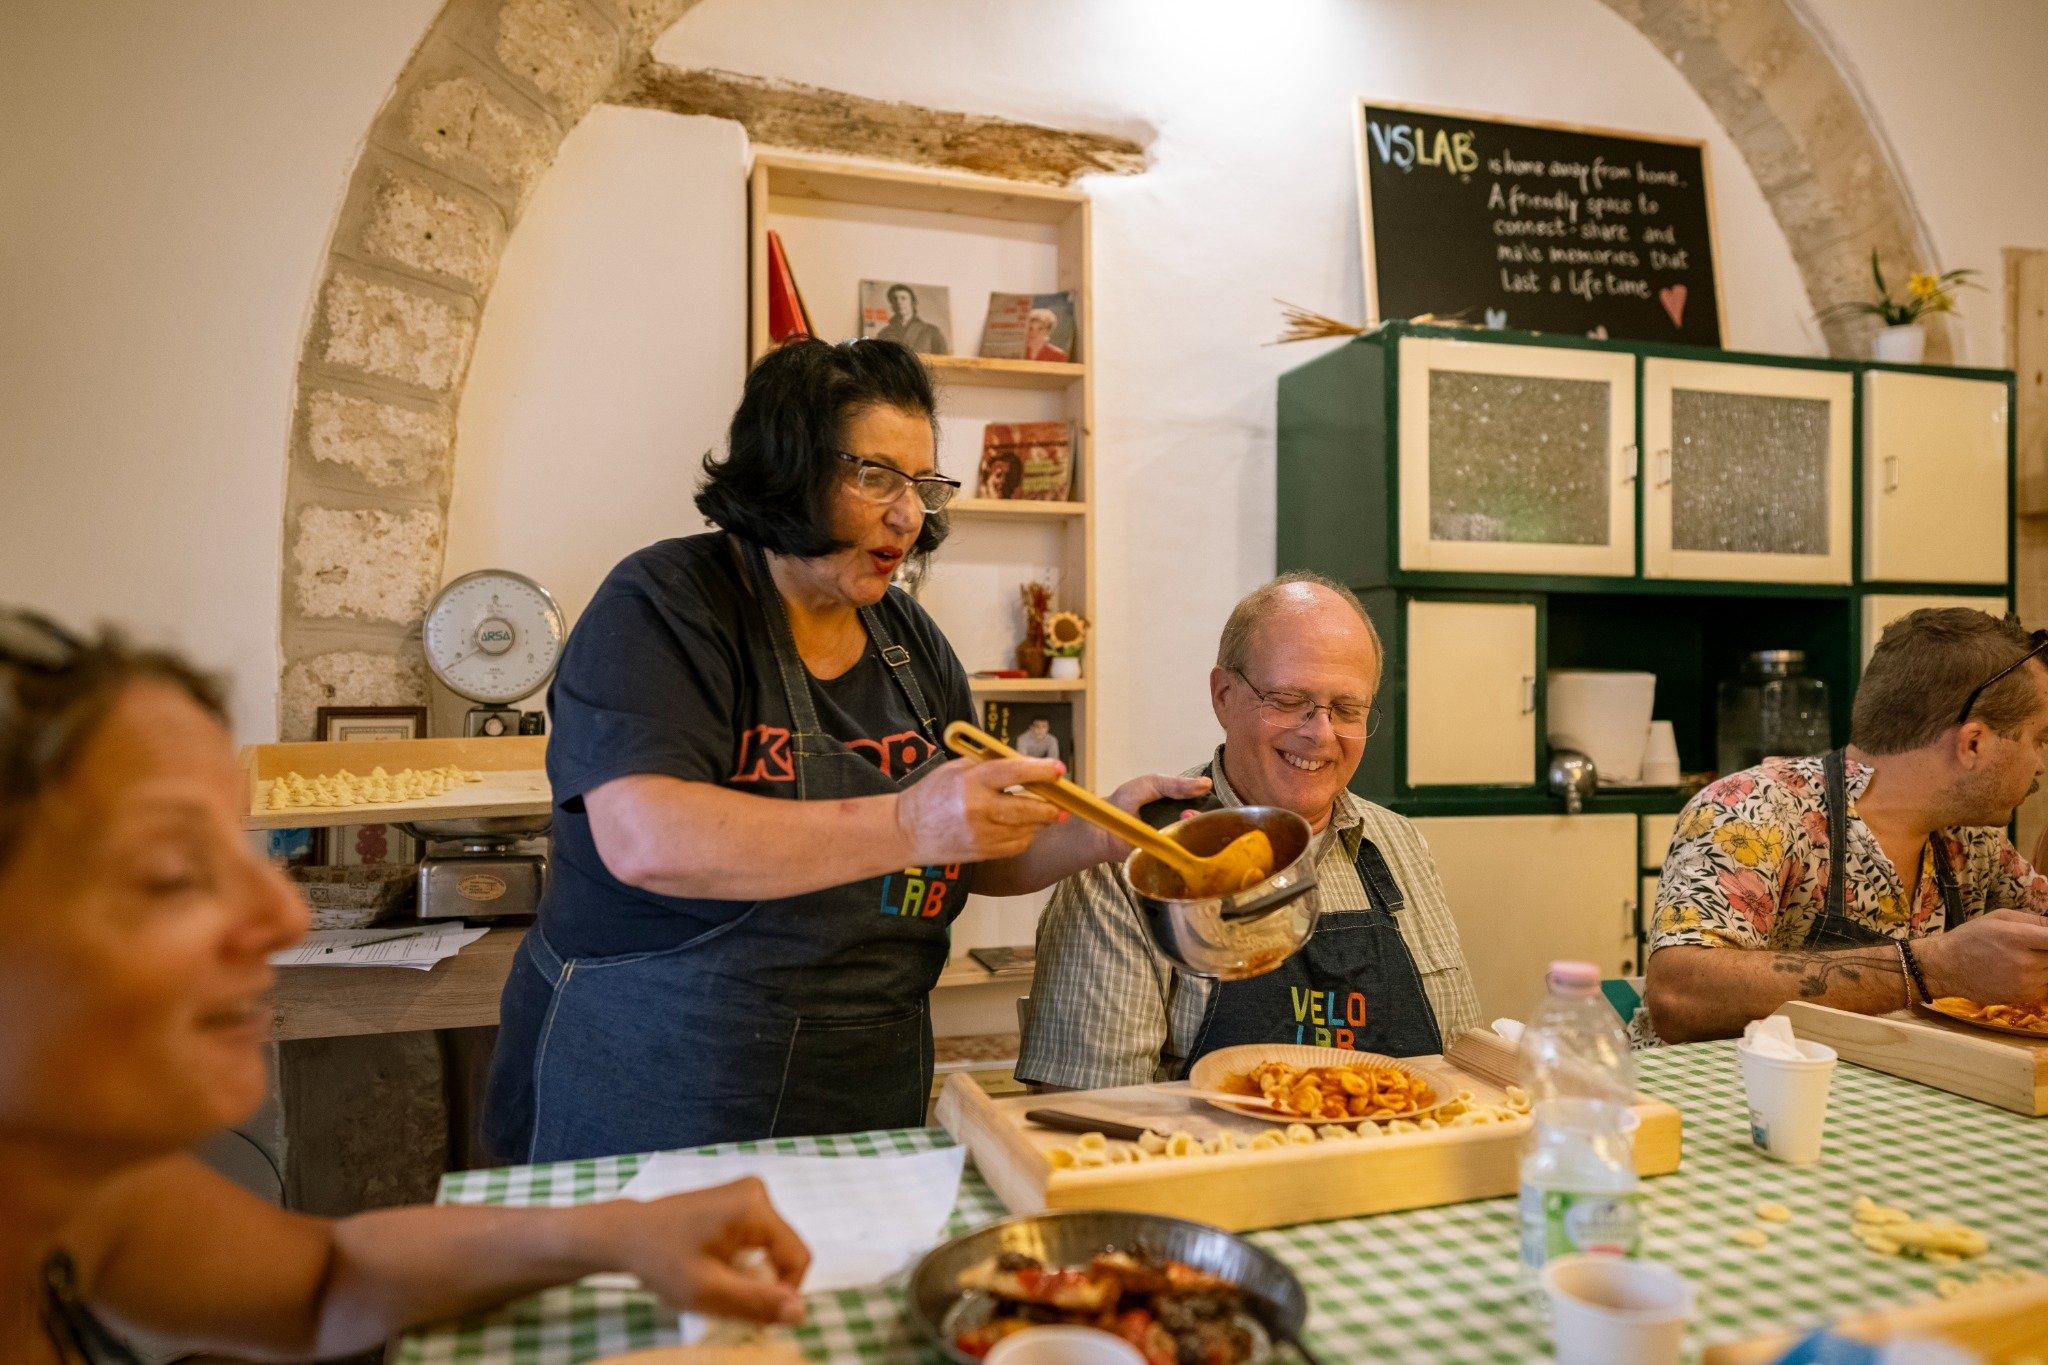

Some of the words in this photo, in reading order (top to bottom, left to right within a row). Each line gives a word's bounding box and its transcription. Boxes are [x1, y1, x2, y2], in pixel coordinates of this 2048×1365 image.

[1503, 148, 1546, 177] home
[1548, 160, 1590, 195] away
[1592, 155, 1632, 191] from
[1487, 182, 1506, 211] A
[1509, 184, 1579, 224] friendly
[1585, 197, 1632, 220] space
[1637, 191, 1660, 216] to
[1580, 219, 1629, 242] share
[1642, 225, 1676, 245] and
[1548, 246, 1640, 268] memories
[1650, 249, 1690, 271] that
[1550, 274, 1562, 294] a
[880, 875, 948, 918] LAB
[1291, 986, 1367, 1027] VELO
